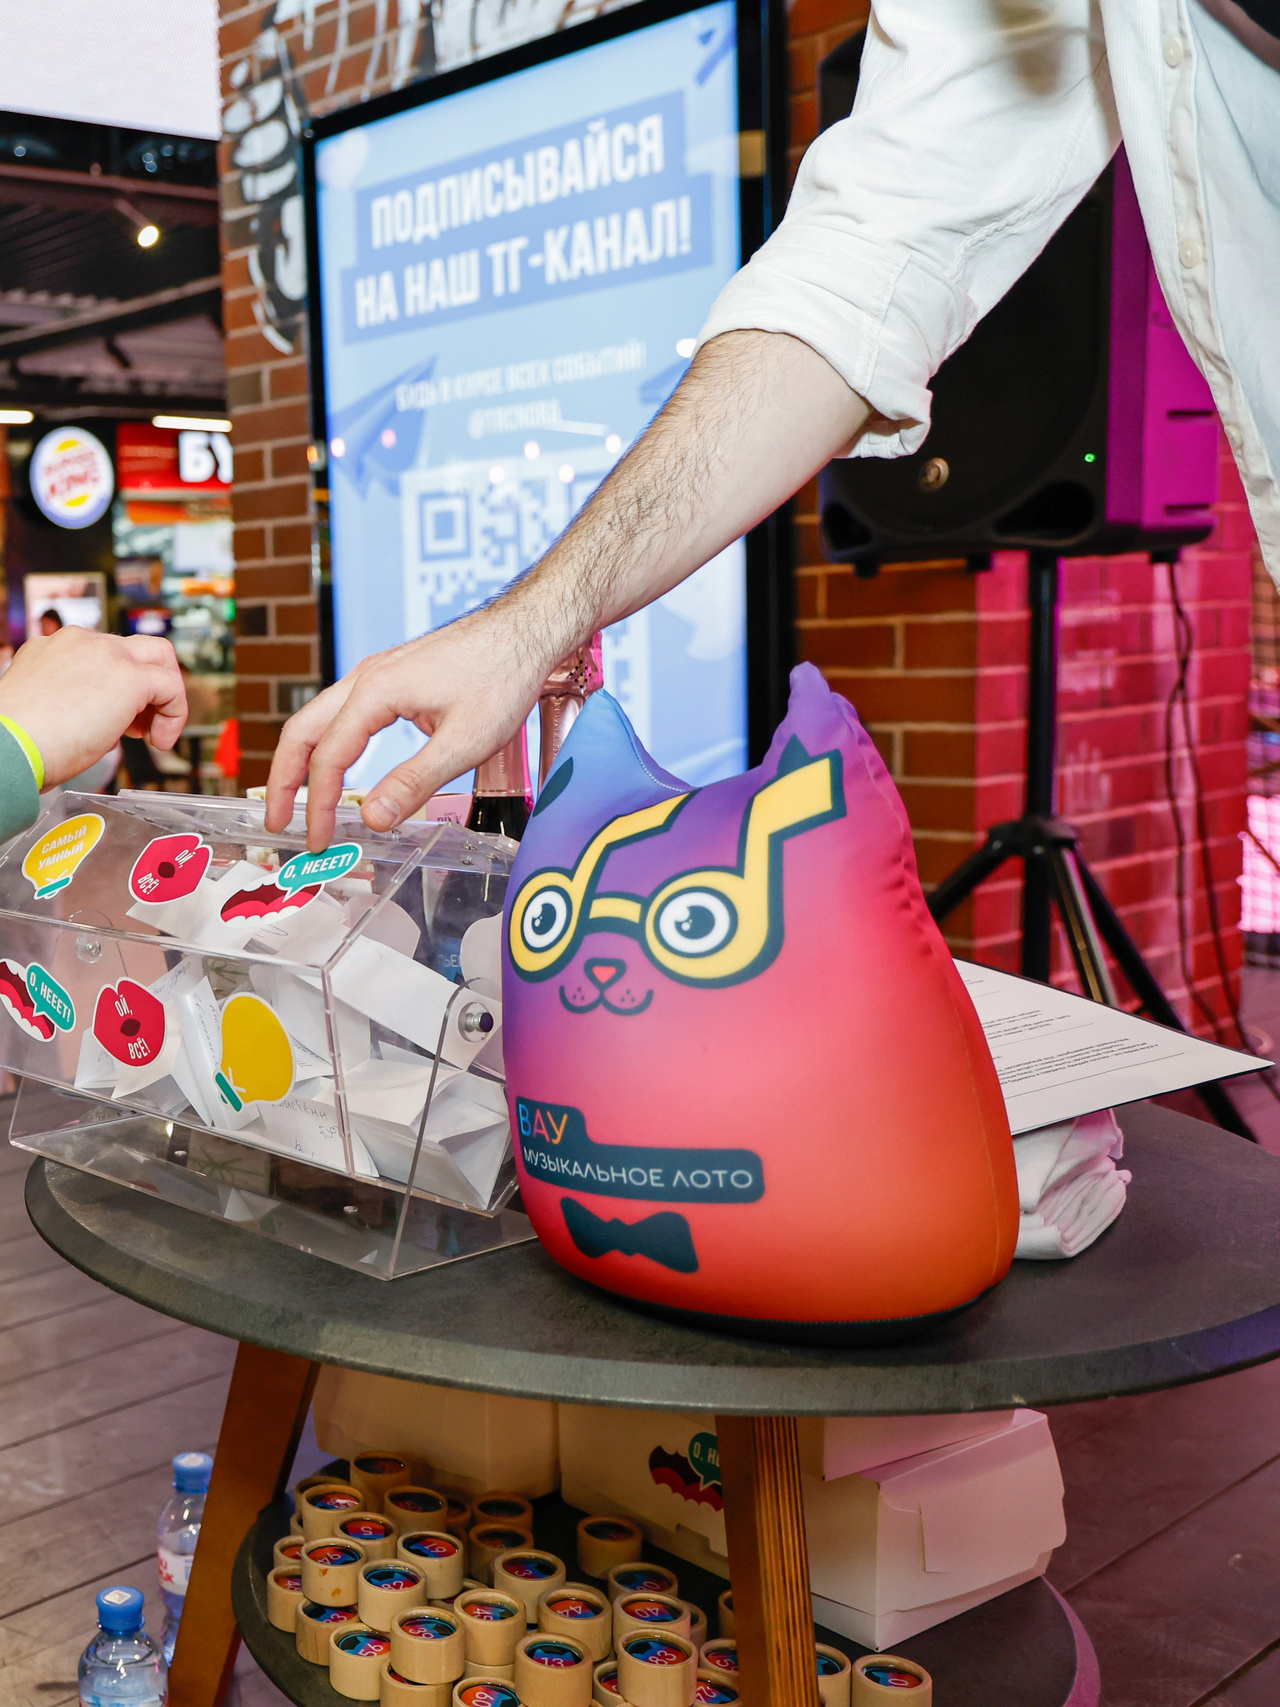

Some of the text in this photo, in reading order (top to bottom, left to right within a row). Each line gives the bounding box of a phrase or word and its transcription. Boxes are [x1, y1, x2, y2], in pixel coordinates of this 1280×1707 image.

[371, 113, 665, 249] ПОДПИСЫВАЙСЯ
[355, 195, 693, 328] НА НАШ ТГ-КАНАЛ!
[454, 365, 505, 401] КУРСЕ
[41, 825, 88, 854] САМЫЙ
[38, 841, 84, 870] УМНЫЙ
[175, 849, 197, 869] ОЙ,
[283, 852, 355, 879] О, НЕЕЕТ!
[137, 872, 161, 895] ВСЁ!
[29, 971, 72, 1023] О, НЕЕЕТ!
[114, 994, 133, 1018] ОЙ,
[127, 1037, 151, 1060] ВСЁ!
[518, 1103, 568, 1144] ВАУ
[523, 1146, 754, 1189] МУЗЫКАЛЬНОЕ ЛОТО
[634, 1605, 661, 1619] 40
